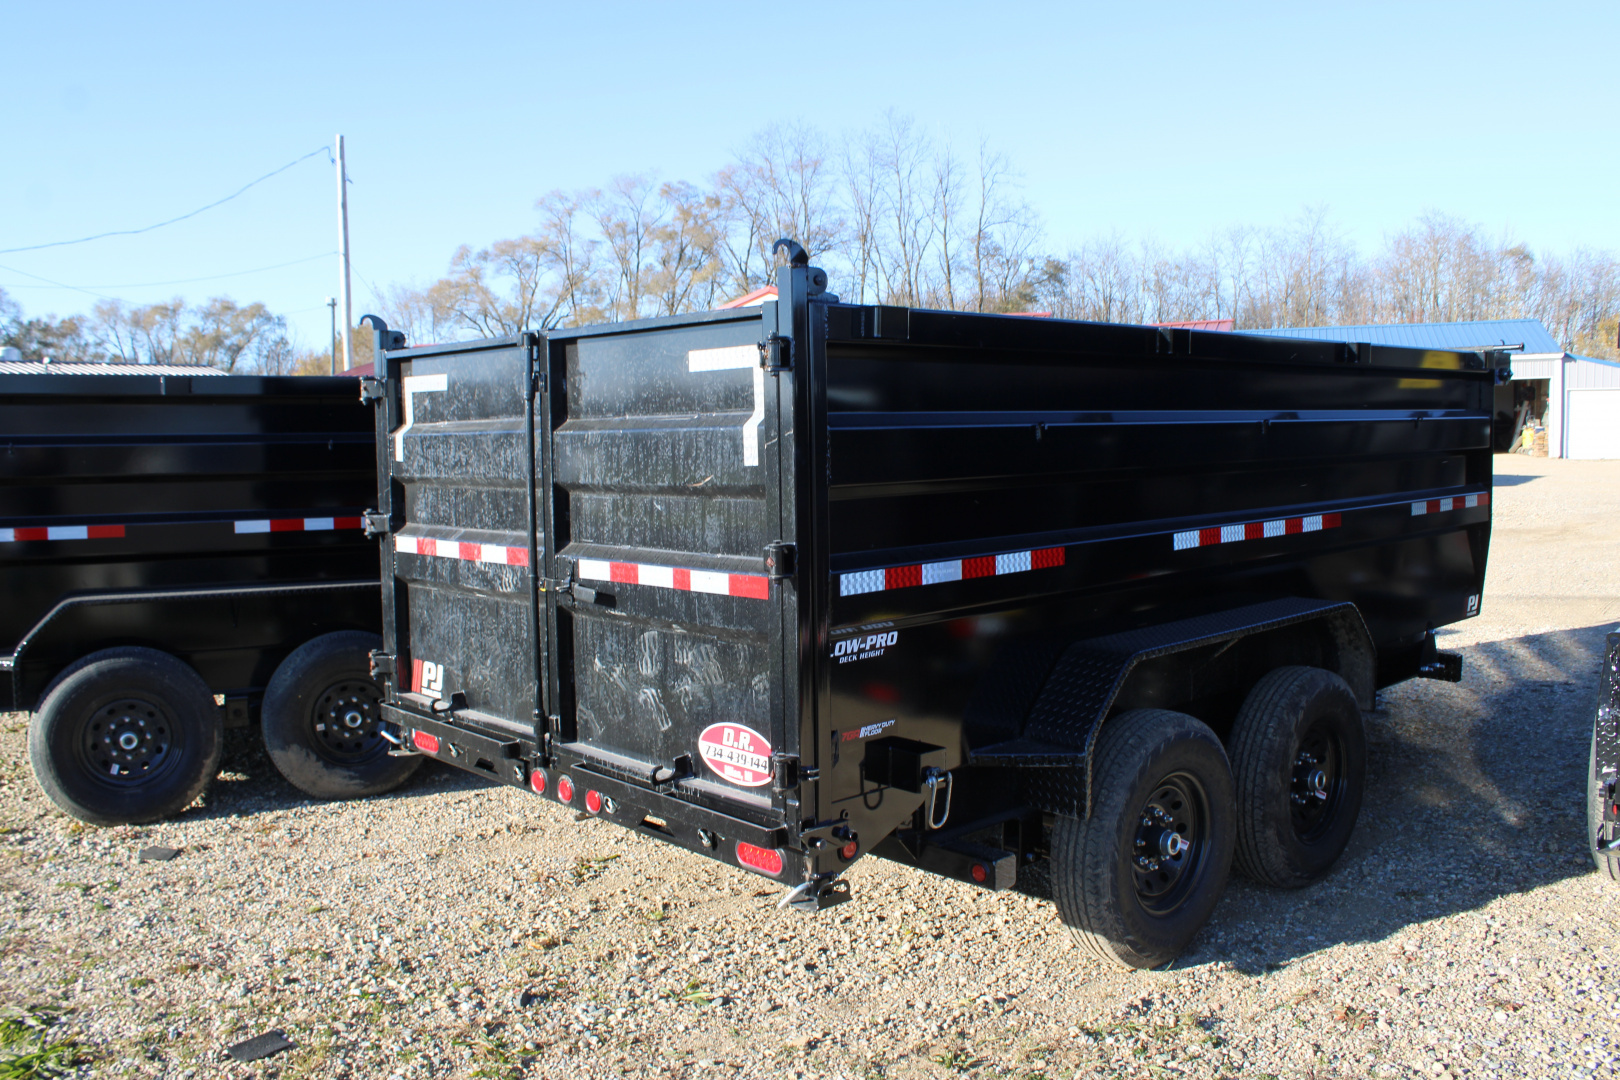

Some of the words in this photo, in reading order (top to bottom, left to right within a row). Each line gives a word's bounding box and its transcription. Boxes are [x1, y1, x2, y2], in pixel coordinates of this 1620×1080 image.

[1467, 594, 1479, 612] PJ
[830, 631, 898, 657] OW-PRO
[839, 654, 857, 664] DECK
[860, 648, 885, 660] HEIGHT
[421, 661, 444, 691] PJ
[722, 727, 754, 752] D.R.
